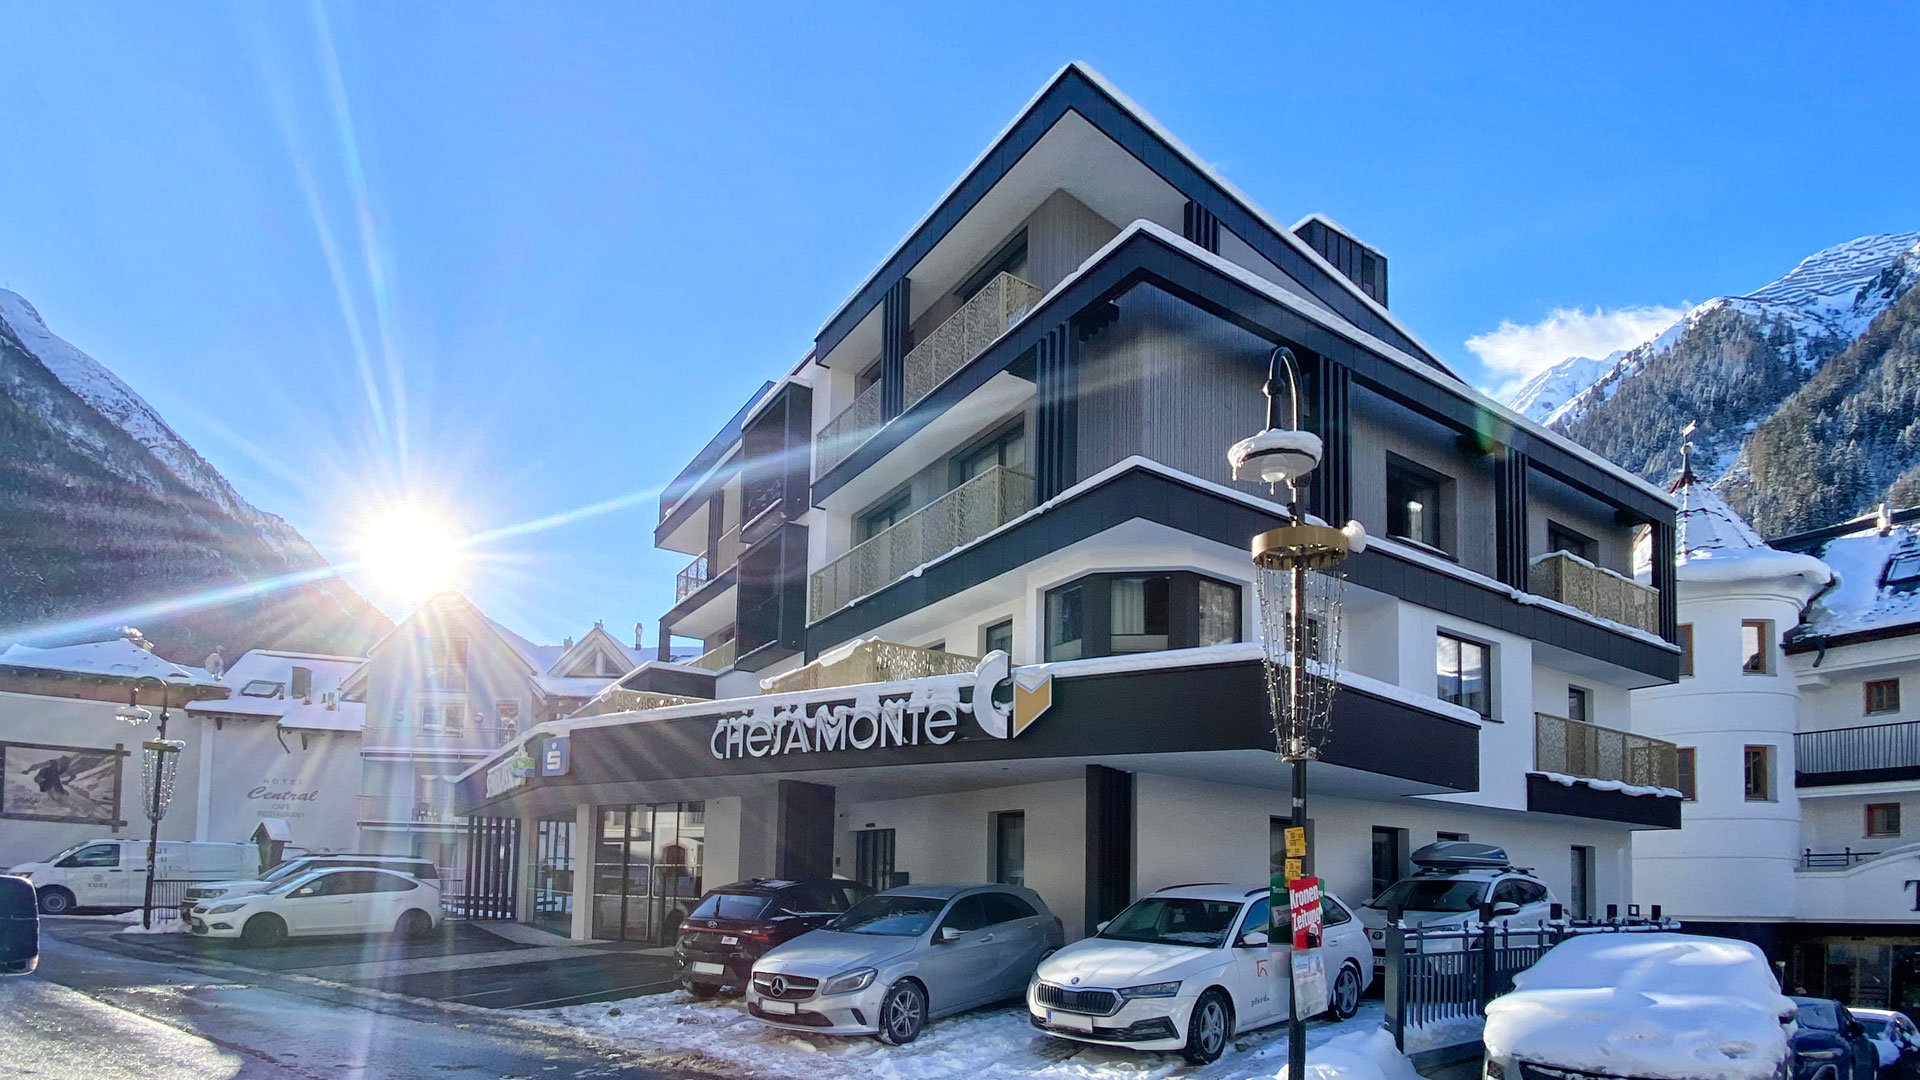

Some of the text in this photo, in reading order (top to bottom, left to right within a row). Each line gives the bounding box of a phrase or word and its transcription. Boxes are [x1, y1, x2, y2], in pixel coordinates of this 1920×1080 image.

[247, 786, 319, 801] Central
[1290, 884, 1319, 910] Kronen
[1291, 906, 1321, 932] Zeitung
